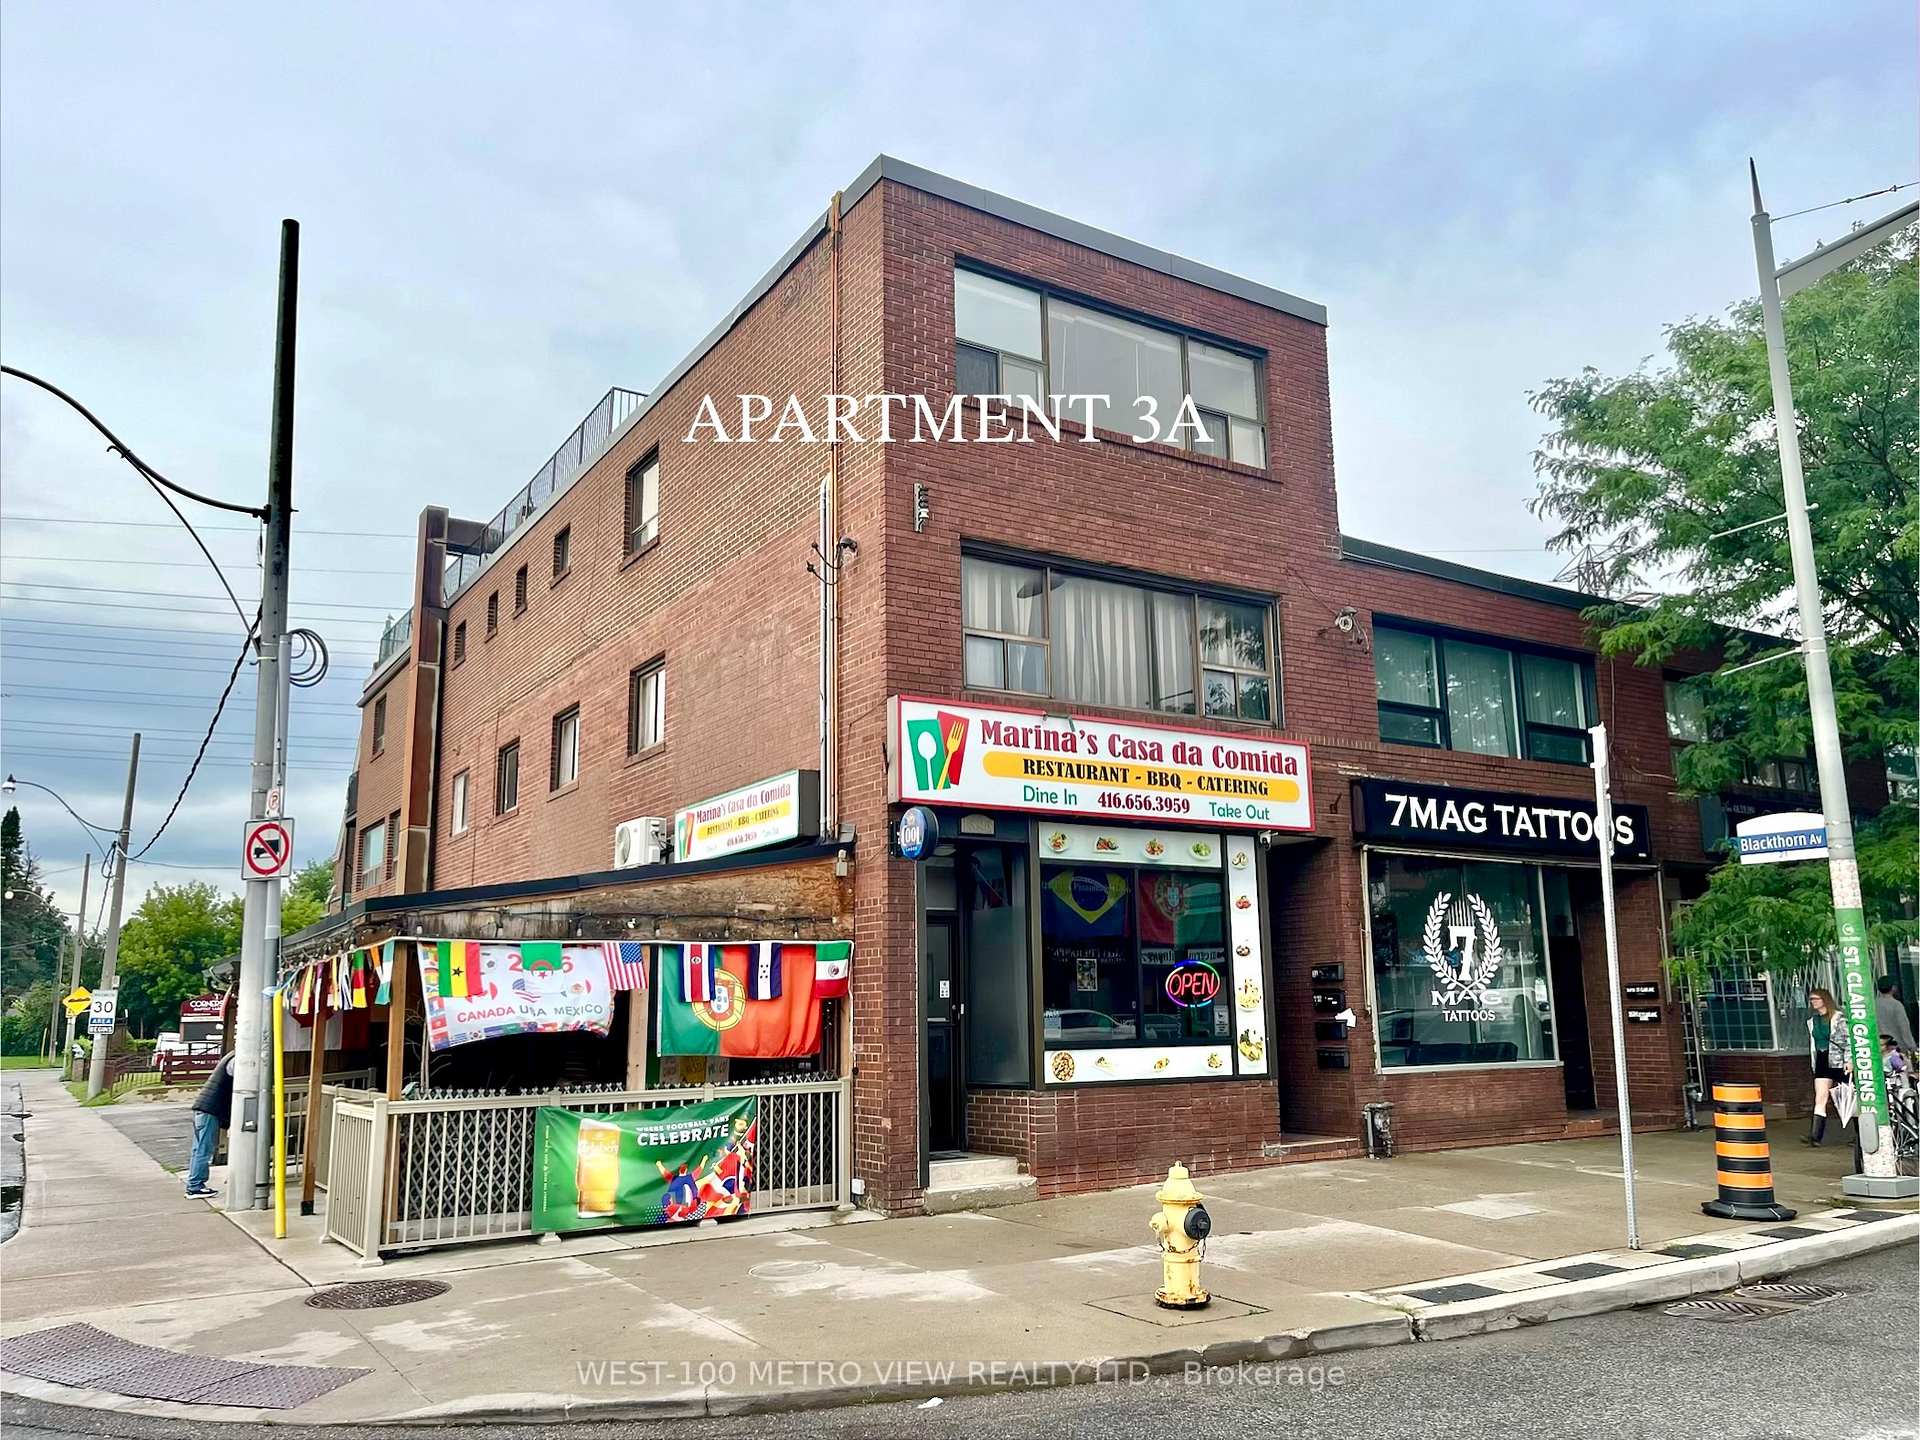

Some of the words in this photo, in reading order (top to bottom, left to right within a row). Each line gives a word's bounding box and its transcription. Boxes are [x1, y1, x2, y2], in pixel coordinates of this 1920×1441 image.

[980, 719, 1098, 756] Marina's
[1108, 733, 1163, 763] Casa
[1172, 741, 1203, 766] da
[1212, 745, 1298, 775] Comida
[1023, 758, 1130, 783] RESTAURANT
[1147, 770, 1181, 789] BBQ
[1197, 775, 1269, 796] CATERING
[1023, 785, 1058, 804] Dine
[1064, 788, 1077, 805] In
[1097, 791, 1190, 814] 416.656.3959
[1209, 801, 1242, 819] Take
[1246, 805, 1270, 820] Out
[1385, 792, 1488, 834] 7MAG
[1740, 833, 1806, 852] Blackthorn
[1809, 833, 1822, 845] Av
[1843, 946, 1860, 968] ST.
[1168, 972, 1215, 996] OPEN
[93, 1001, 113, 1013] 30
[1431, 990, 1501, 1006] MAG
[1846, 972, 1867, 1020] CLAIR
[457, 1005, 515, 1023] CANADA
[554, 1003, 603, 1017] MEXICO
[1442, 1010, 1496, 1022] TATTOOS
[1852, 1024, 1876, 1102] GARDENS
[637, 1124, 729, 1146] CELEBRATE
[666, 1120, 707, 1131] FOOTBALL
